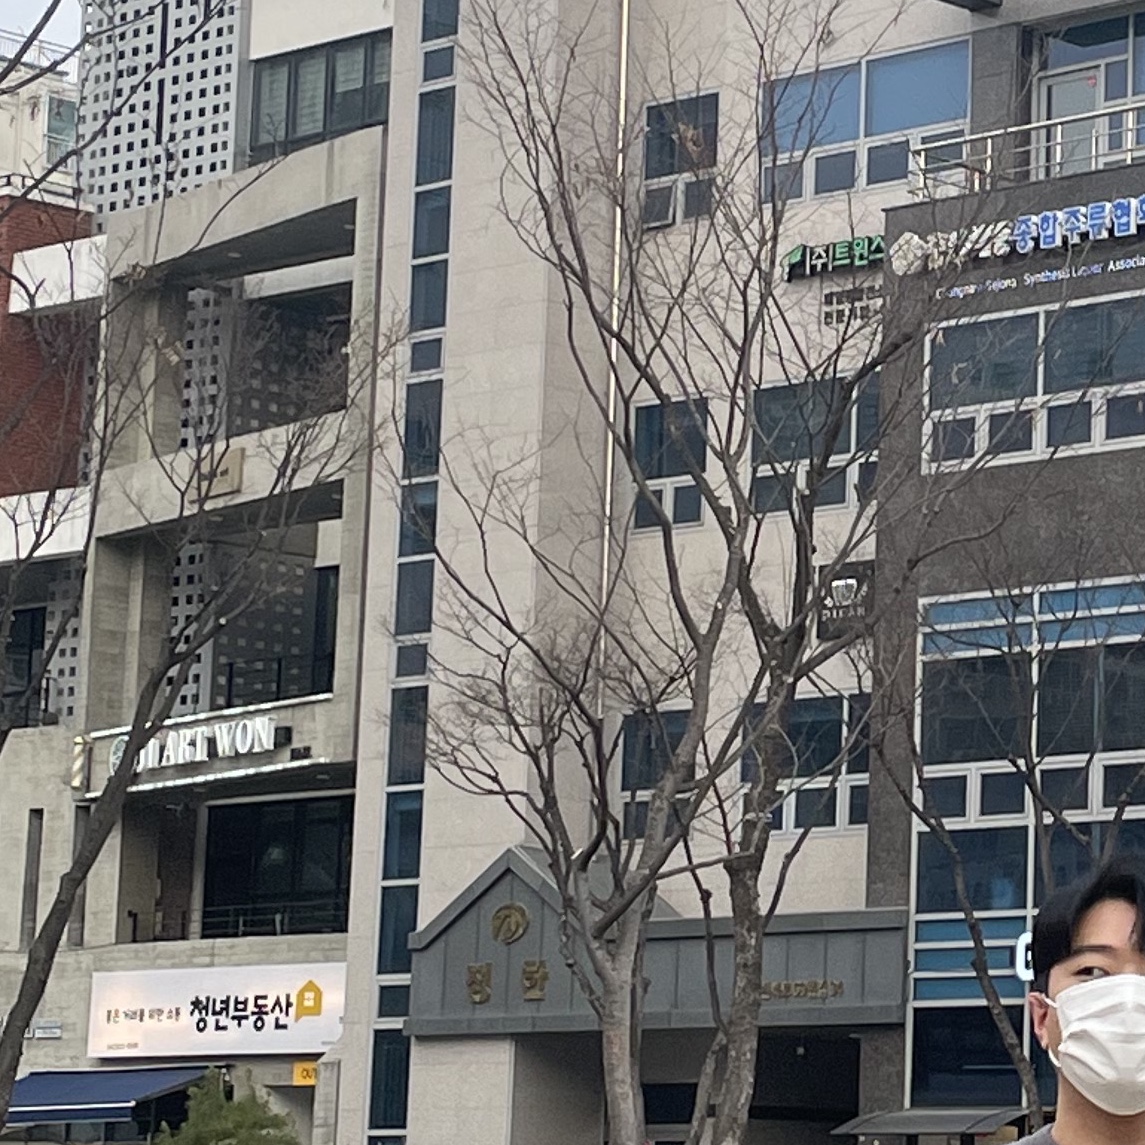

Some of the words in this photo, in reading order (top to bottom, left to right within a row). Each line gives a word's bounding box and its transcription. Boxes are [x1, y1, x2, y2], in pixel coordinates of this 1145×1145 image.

[161, 725, 209, 767] ART
[214, 715, 277, 758] WON
[189, 992, 294, 1033] 청년부동산
